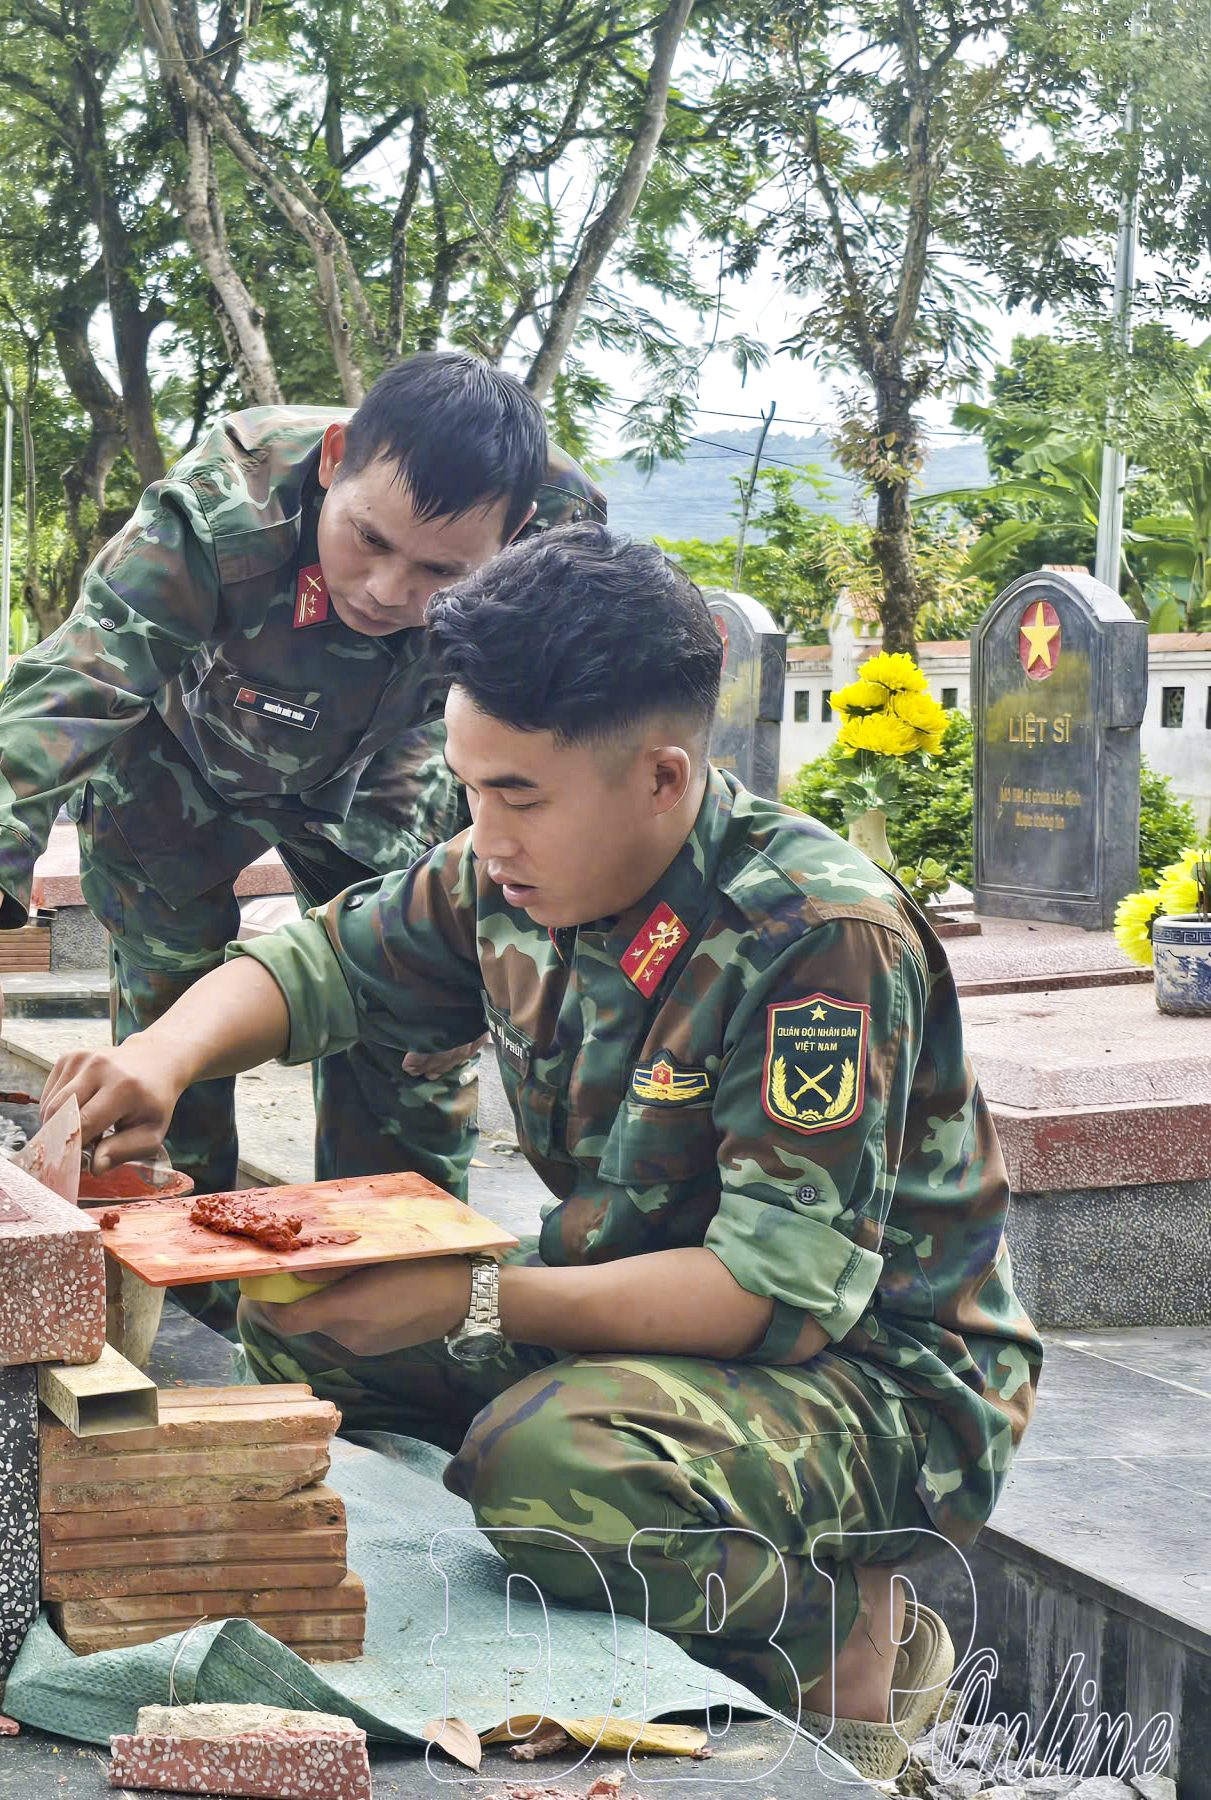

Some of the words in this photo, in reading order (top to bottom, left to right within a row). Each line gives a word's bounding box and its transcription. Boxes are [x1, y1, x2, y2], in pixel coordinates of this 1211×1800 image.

[1009, 711, 1048, 750] LIỆT
[1052, 711, 1072, 743] SĨ
[777, 1025, 800, 1037] QUÂN
[801, 1026, 816, 1039] ĐỘI
[817, 1026, 840, 1037] NHÂN
[841, 1026, 857, 1037] DÂN
[794, 1040, 816, 1053] VIỆT
[817, 1042, 838, 1051] NAM
